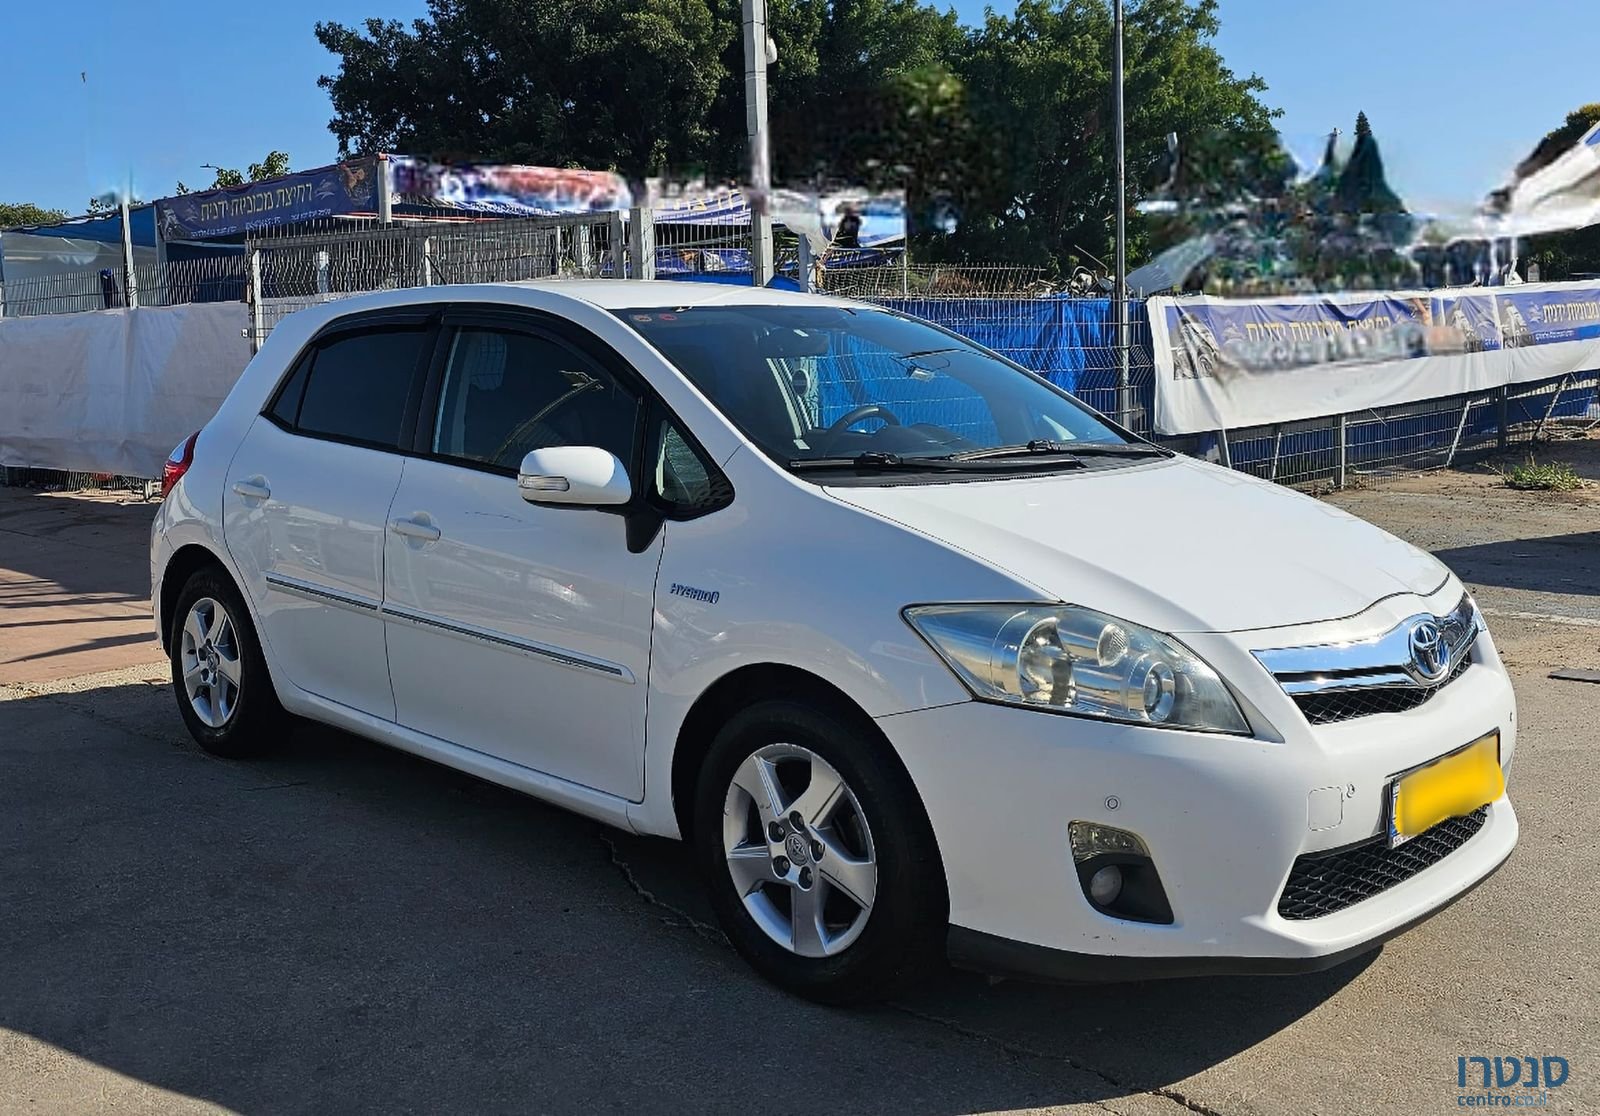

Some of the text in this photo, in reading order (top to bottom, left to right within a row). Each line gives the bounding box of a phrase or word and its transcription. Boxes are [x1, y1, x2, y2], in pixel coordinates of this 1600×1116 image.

[231, 192, 274, 216] מכוניות
[276, 183, 312, 208] רחיצת
[201, 200, 229, 221] ידנית
[1543, 302, 1599, 323] מכוניות ידנית
